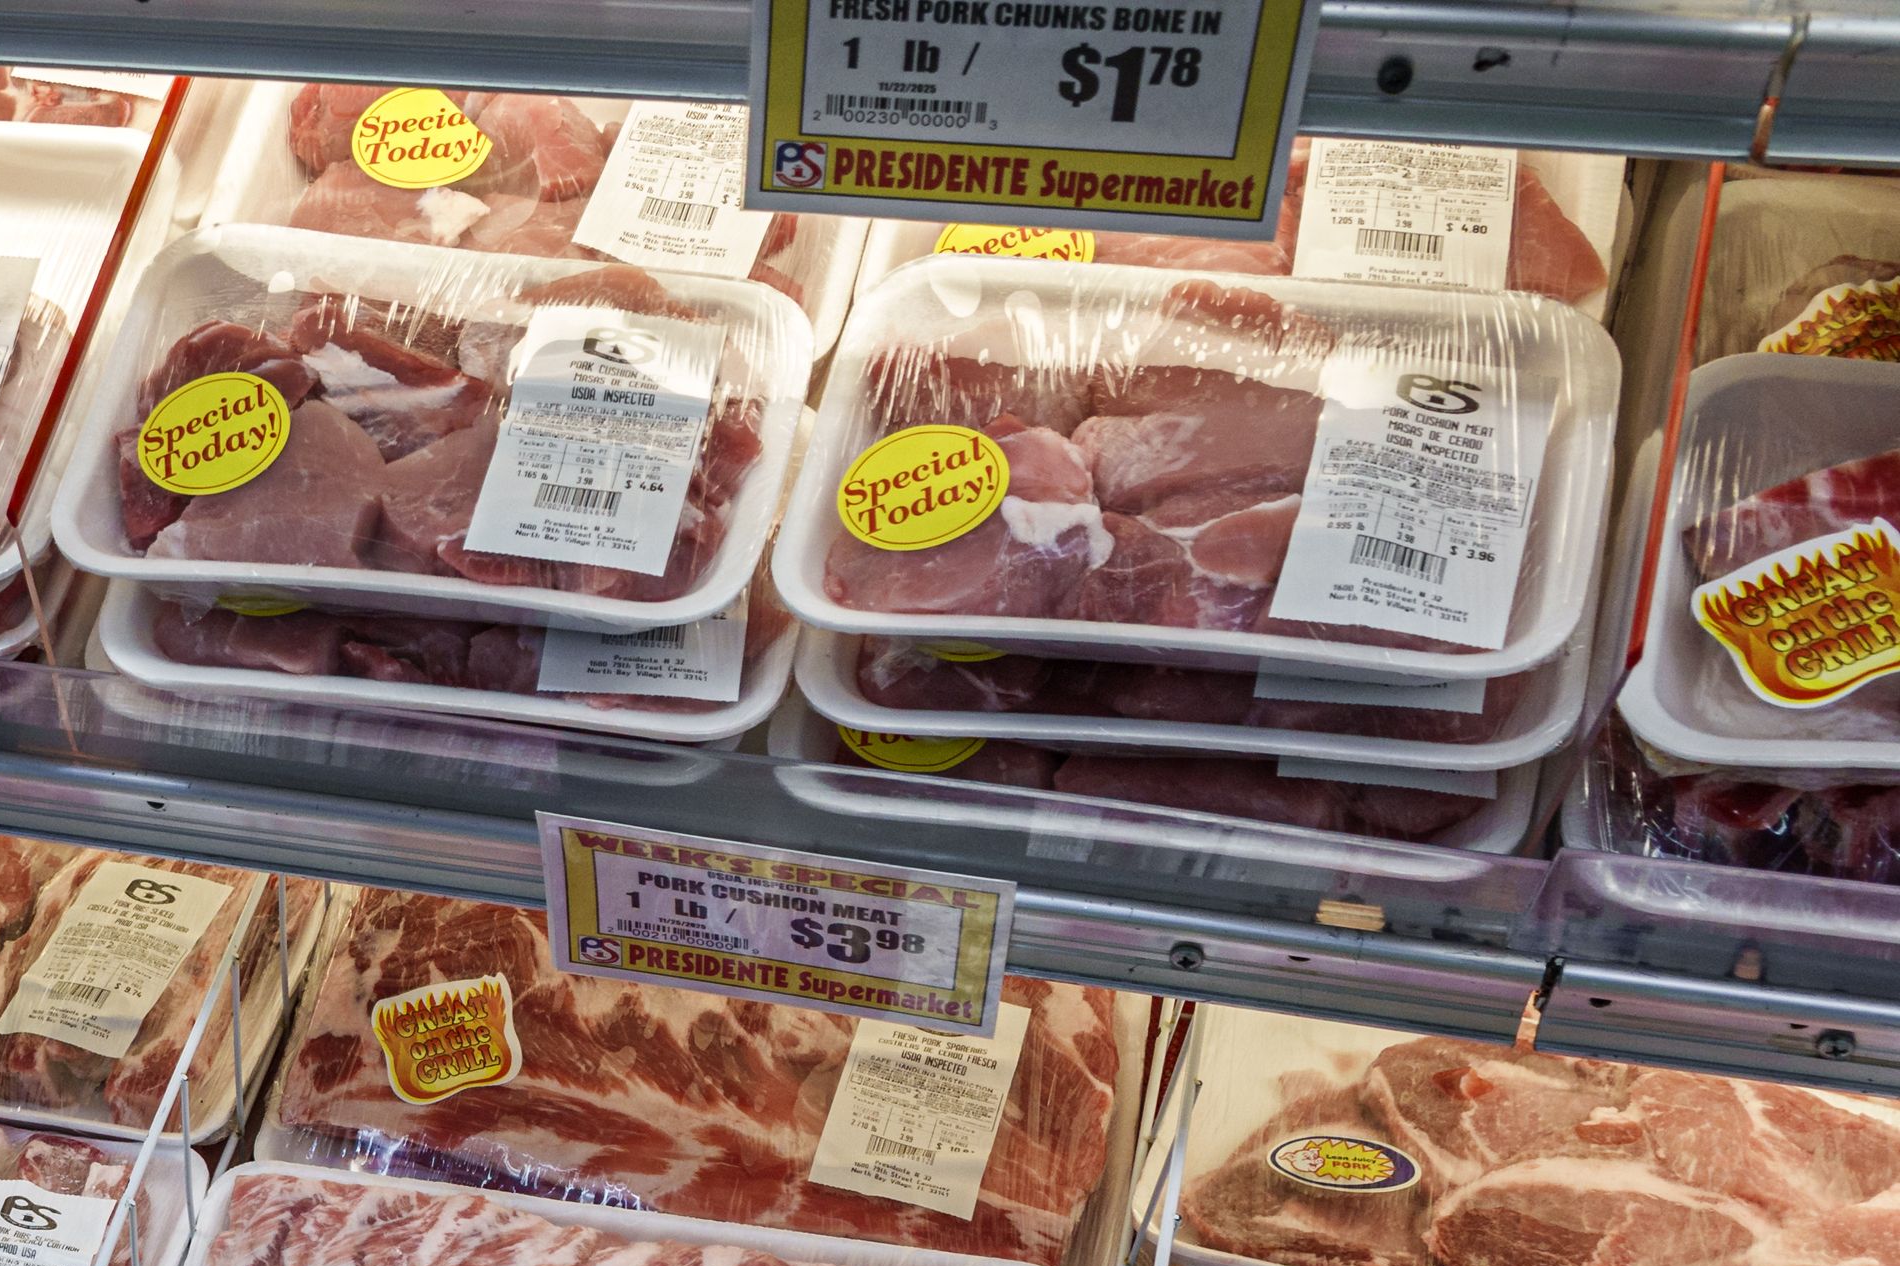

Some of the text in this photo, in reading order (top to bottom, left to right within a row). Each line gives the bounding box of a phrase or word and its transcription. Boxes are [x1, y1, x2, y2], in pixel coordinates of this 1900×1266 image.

[829, 0, 1222, 36] FRESH PORK CHUNKS BONE IN
[843, 37, 861, 69] 1
[904, 40, 940, 73] lb
[878, 80, 937, 95] 11/22/2025
[359, 108, 467, 141] Specia
[364, 131, 484, 168] Today!
[833, 149, 1257, 210] PRESIDENTE Supermarket
[143, 384, 268, 455] Special
[1388, 420, 1423, 437] MASAS
[1429, 430, 1442, 441] DE
[1415, 413, 1460, 431] CUSHION
[1465, 423, 1495, 438] MEAT
[155, 413, 277, 481] Today!
[1386, 434, 1479, 464] USDA INSPECTED
[844, 436, 986, 509] Special
[857, 466, 994, 537] Today!
[1734, 551, 1878, 627] GREAT
[1768, 591, 1893, 652] on the
[576, 832, 983, 909] WEEK'S SPECIAL
[747, 878, 819, 895] INSPECTED
[625, 891, 641, 909] 1
[675, 898, 708, 920] Lb
[638, 871, 902, 926] PORK CUSHION MEAT
[628, 944, 974, 1019] PRESIDENTE Supermarket
[394, 1000, 490, 1038] GREAT
[409, 1022, 492, 1060] on the
[415, 1045, 501, 1084] GRILL
